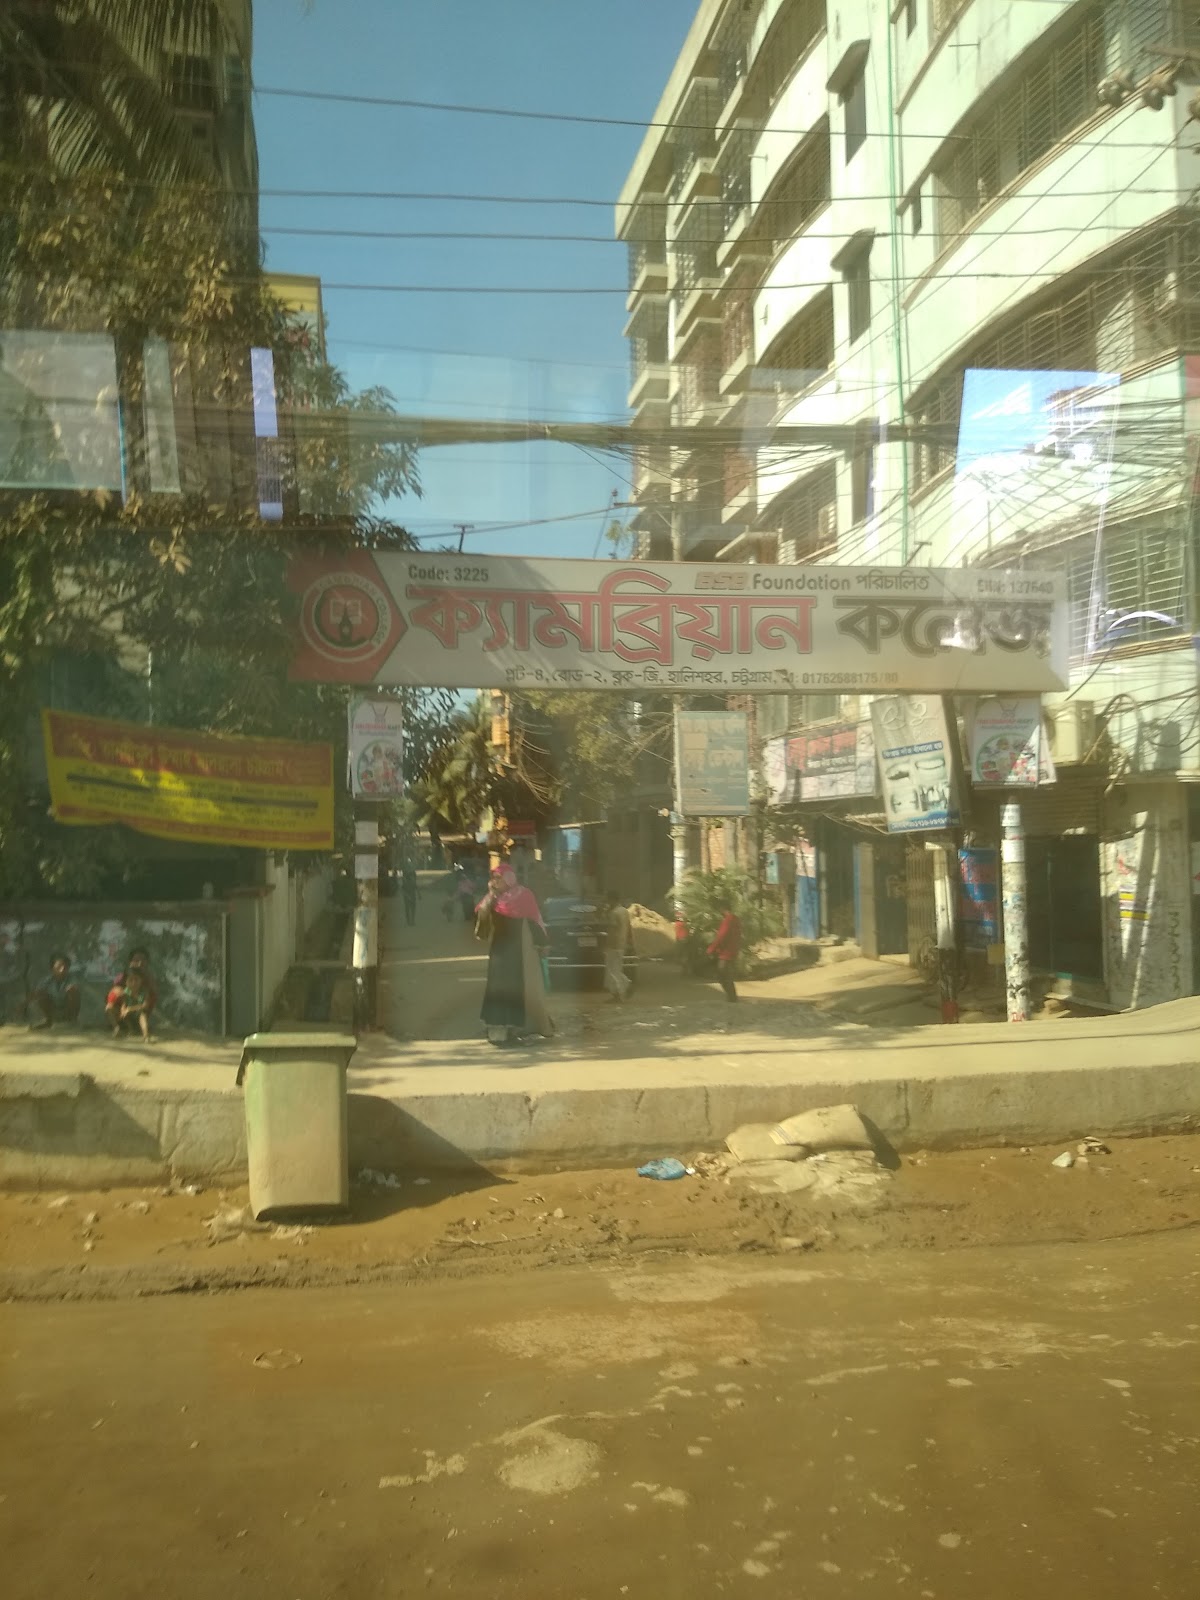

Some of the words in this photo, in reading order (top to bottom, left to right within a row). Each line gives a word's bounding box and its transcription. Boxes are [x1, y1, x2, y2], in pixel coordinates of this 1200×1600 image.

[408, 564, 449, 580] Code:
[454, 566, 489, 582] 3225
[752, 573, 851, 591] Foundation
[855, 569, 930, 590] পরিচালিত
[405, 568, 818, 667] ক্যামব্রিয়ান
[832, 596, 1054, 659] কলেজ
[667, 666, 728, 685] হালিশহর,
